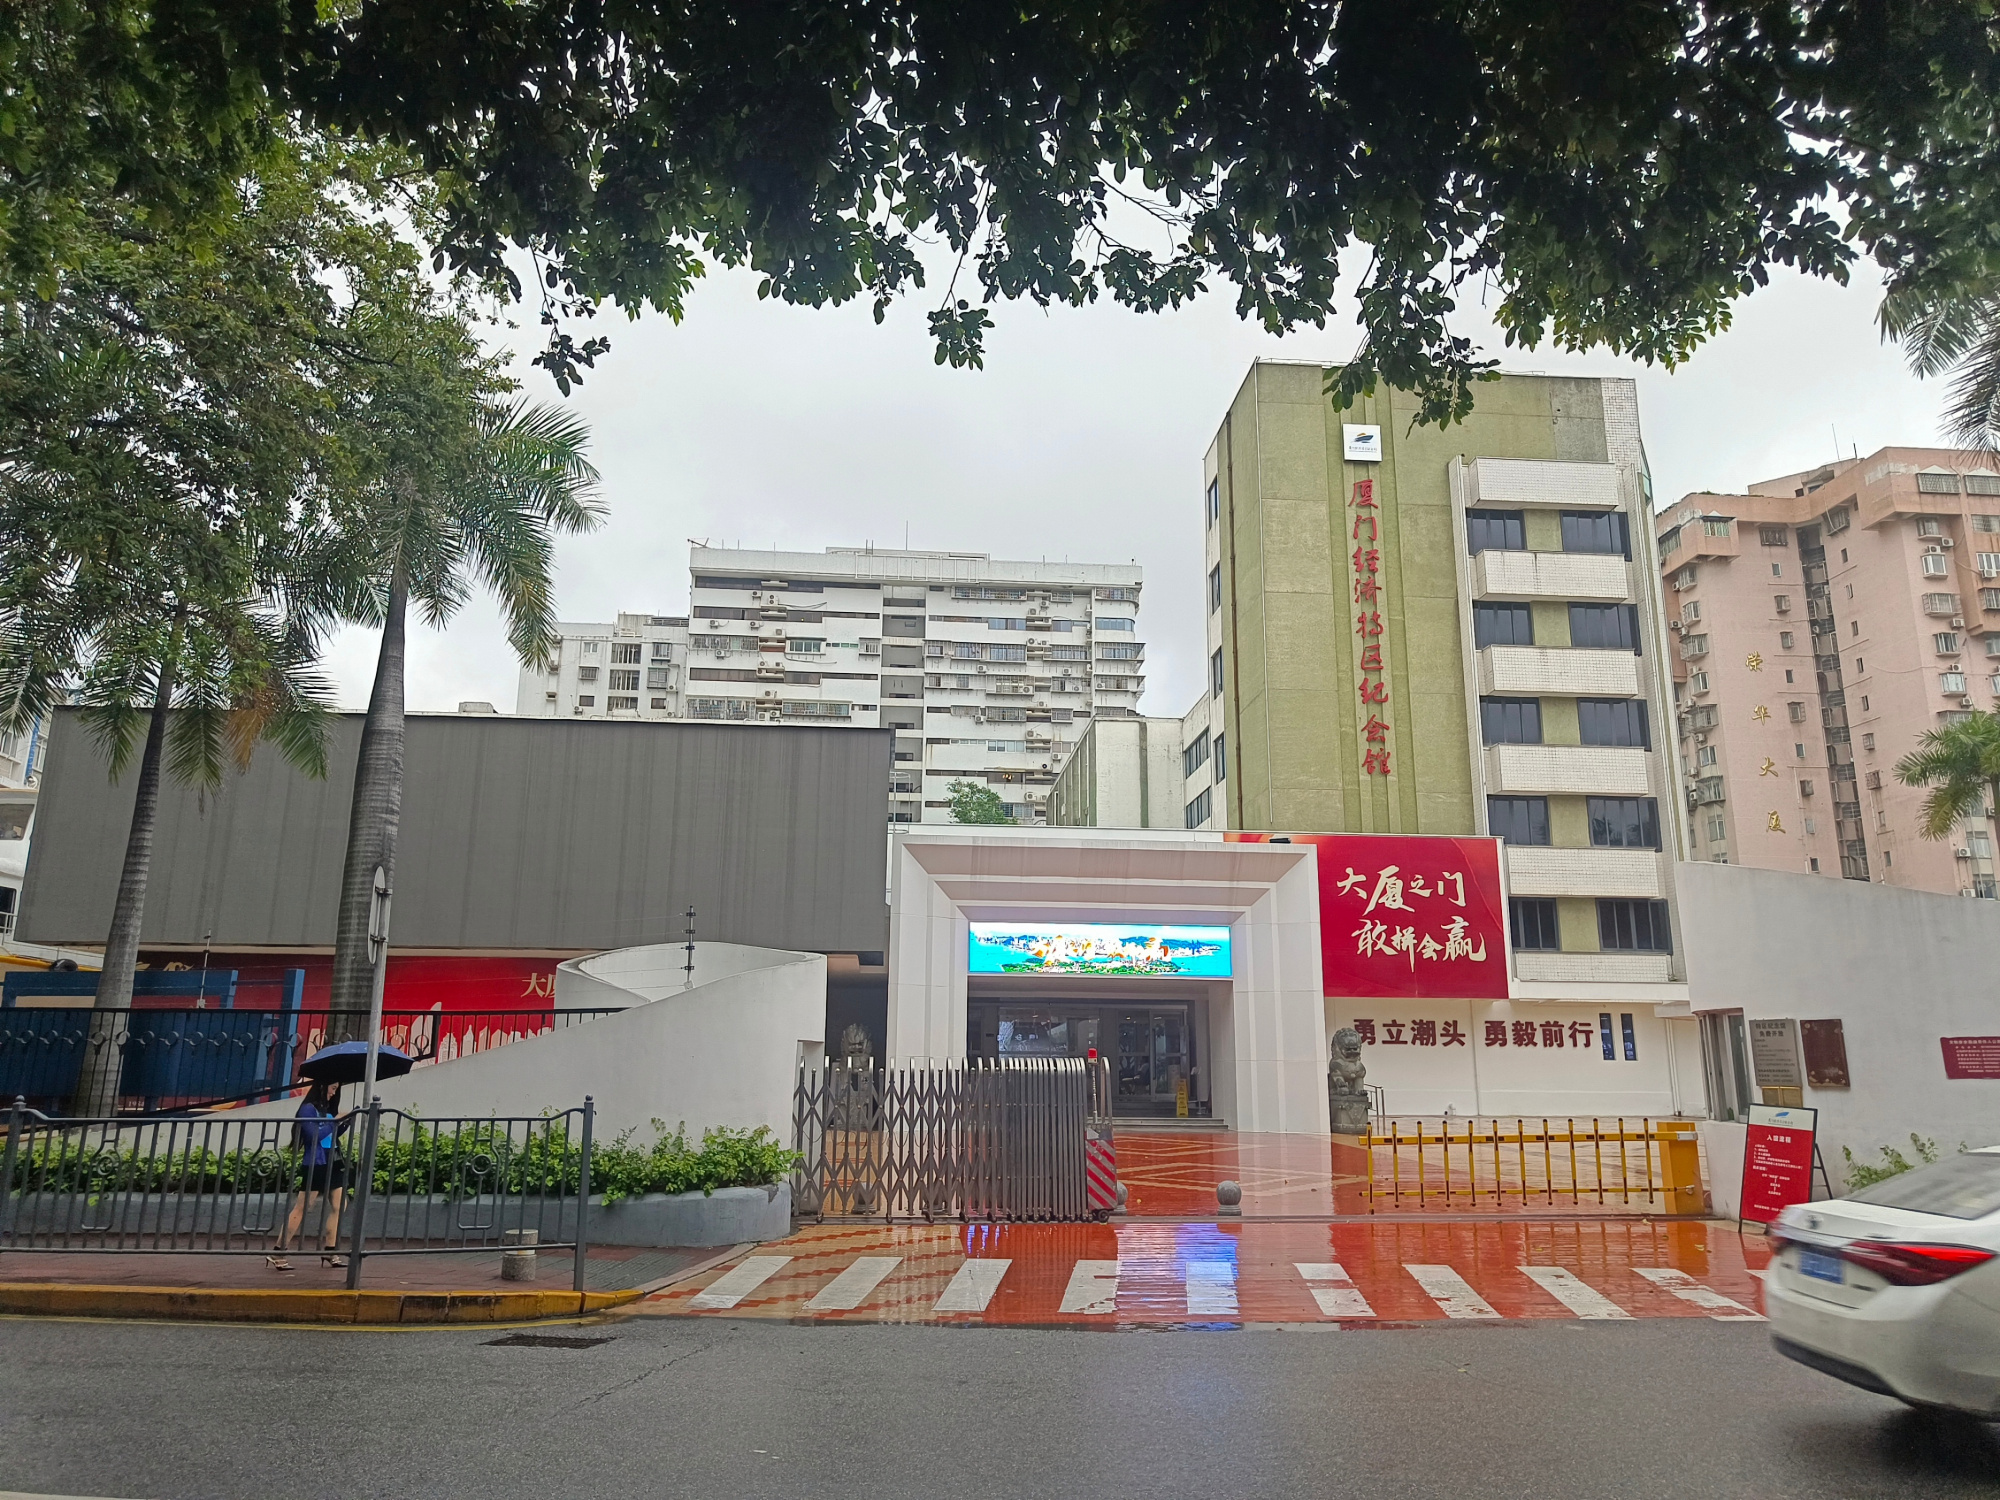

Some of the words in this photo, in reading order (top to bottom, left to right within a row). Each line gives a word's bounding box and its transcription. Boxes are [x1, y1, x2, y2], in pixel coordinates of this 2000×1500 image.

[1348, 478, 1391, 775] 厦门经济特区纪念馆
[1745, 651, 1786, 834] 荣华大厦
[1336, 864, 1467, 916] 大厦之门
[1351, 915, 1487, 973] 敢拼会赢
[1353, 1018, 1466, 1047] 勇立潮头
[1484, 1019, 1594, 1048] 勇毅前行
